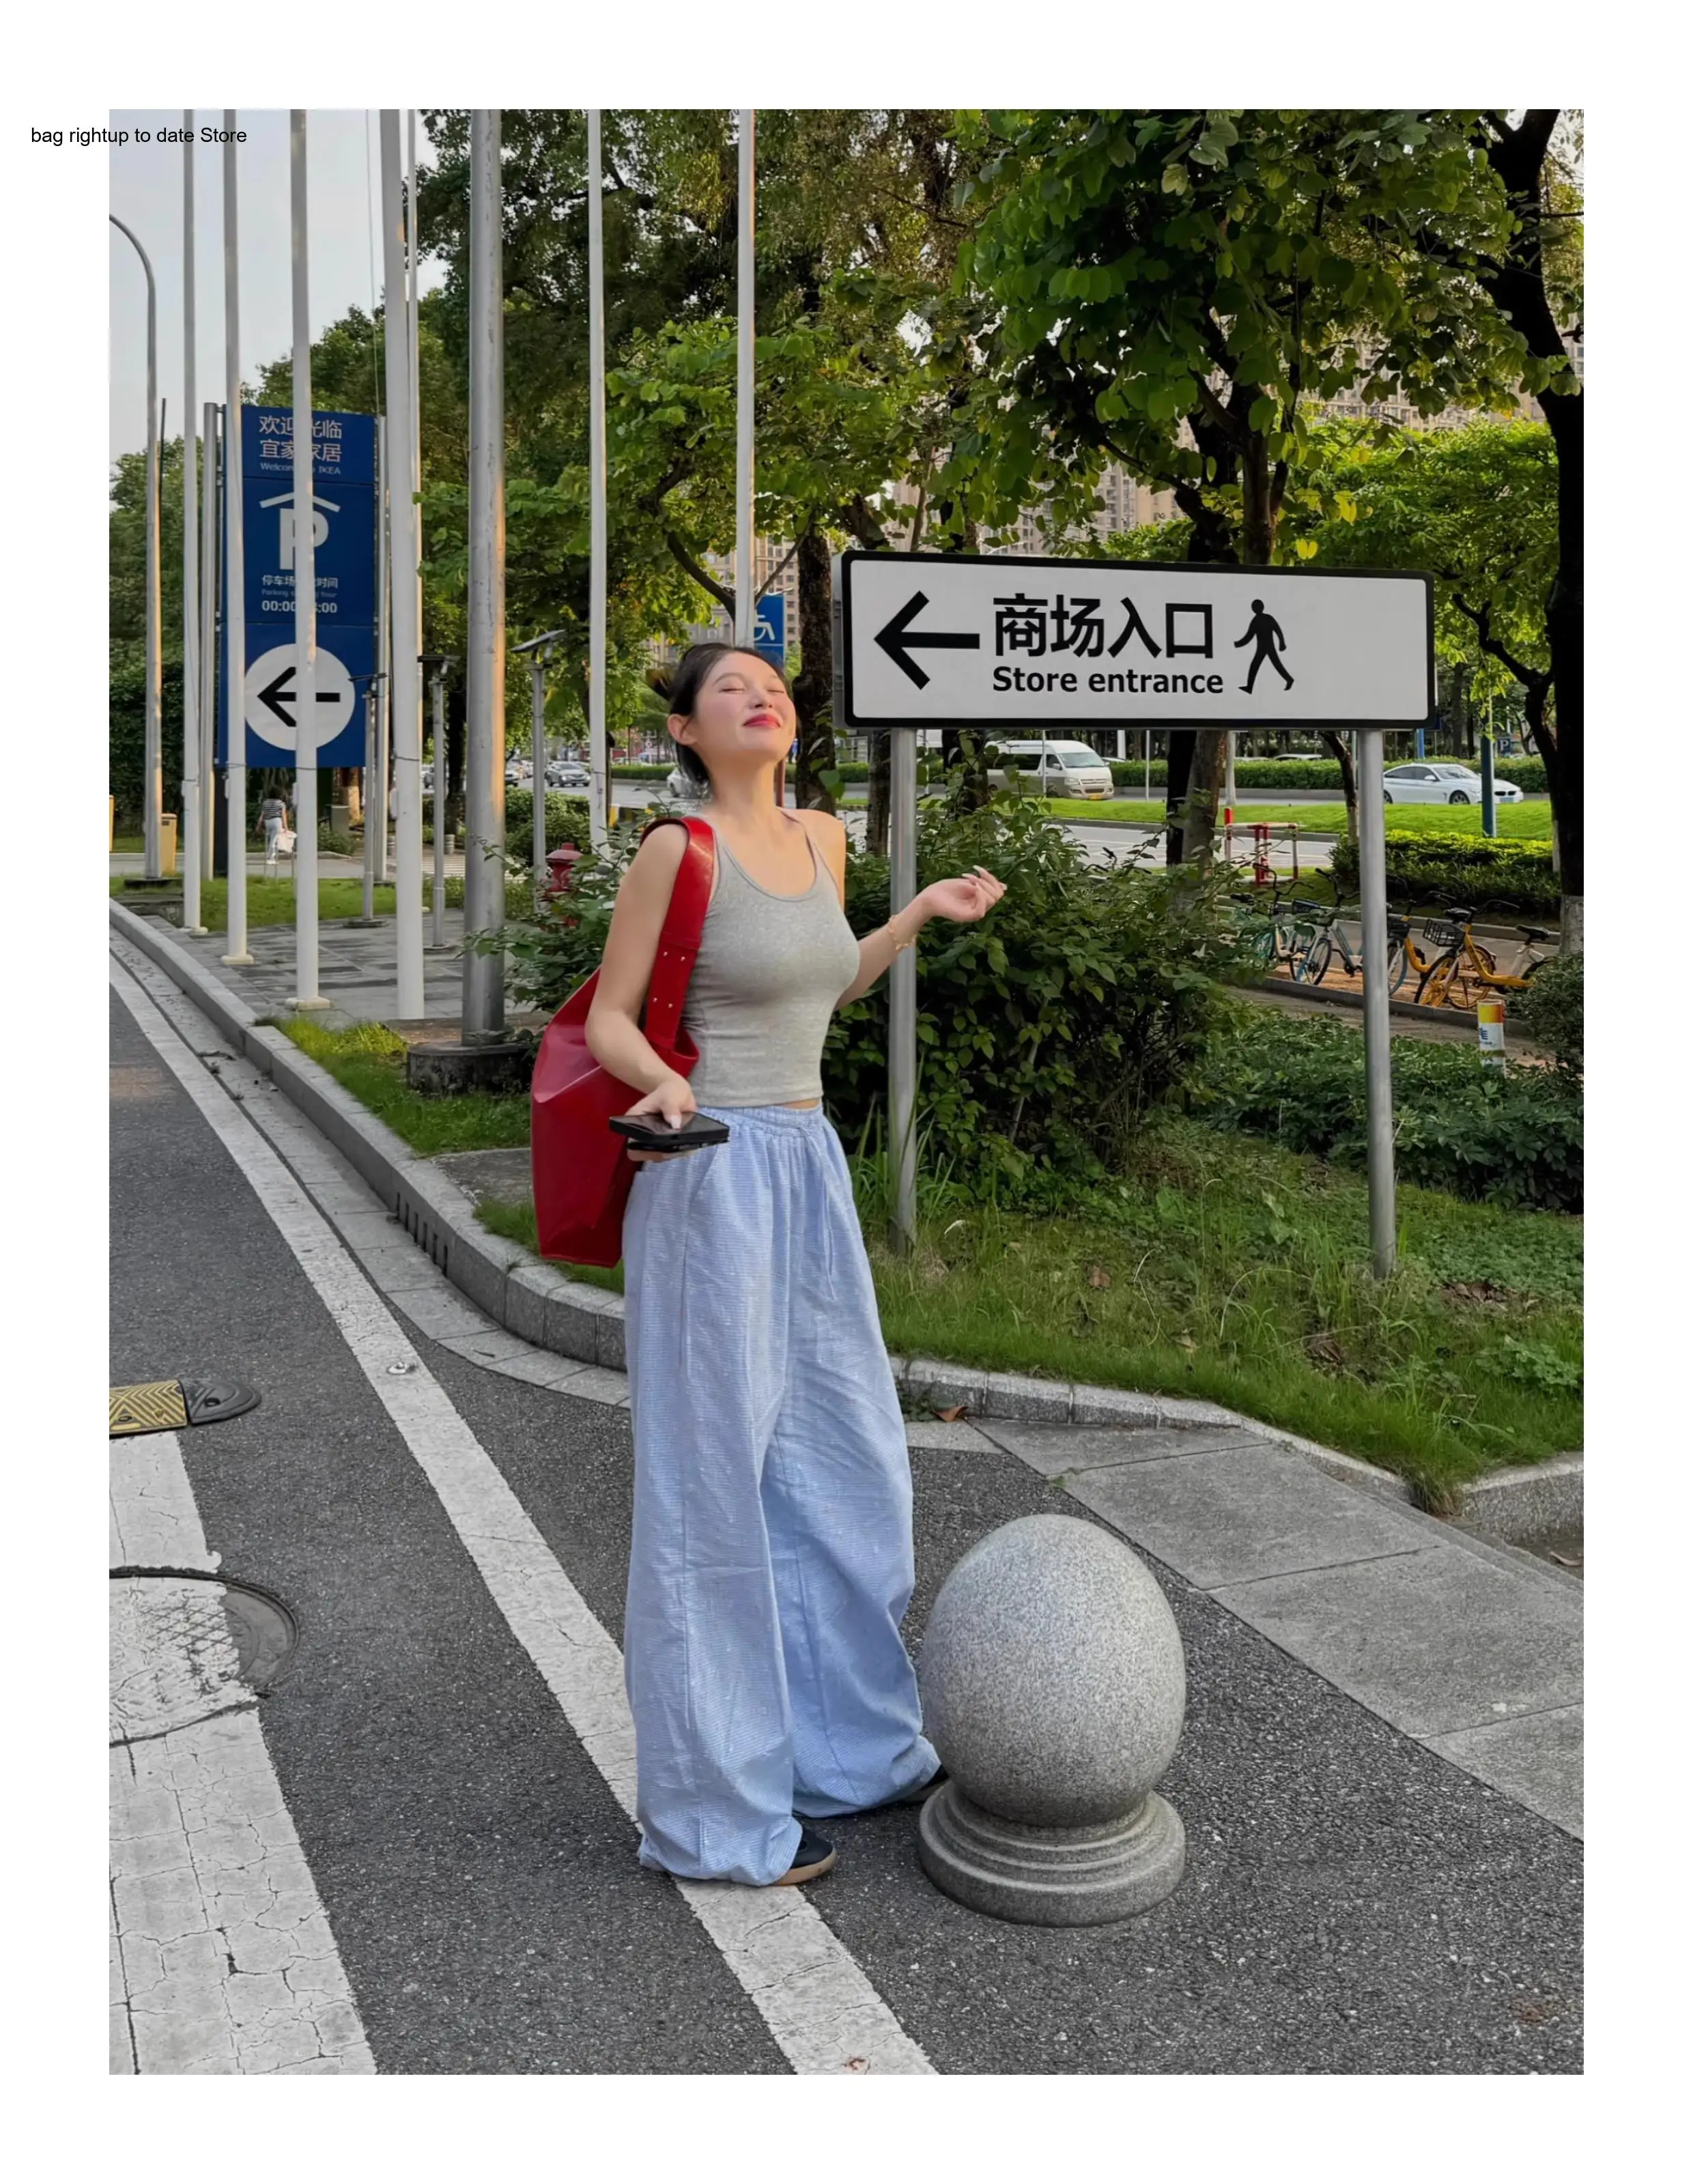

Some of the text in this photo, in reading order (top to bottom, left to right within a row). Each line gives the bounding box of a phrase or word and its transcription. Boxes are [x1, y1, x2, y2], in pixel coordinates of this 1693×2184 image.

[259, 415, 342, 439] 欢迎光临
[260, 462, 294, 472] Welcom
[318, 465, 341, 474] IKEA
[279, 508, 329, 570] P
[262, 575, 338, 588] 停车场时间
[262, 601, 337, 613] 00:00:00
[993, 592, 1214, 659] 商场入口
[993, 666, 1223, 694] Store entrance
[1498, 739, 1509, 751] P
